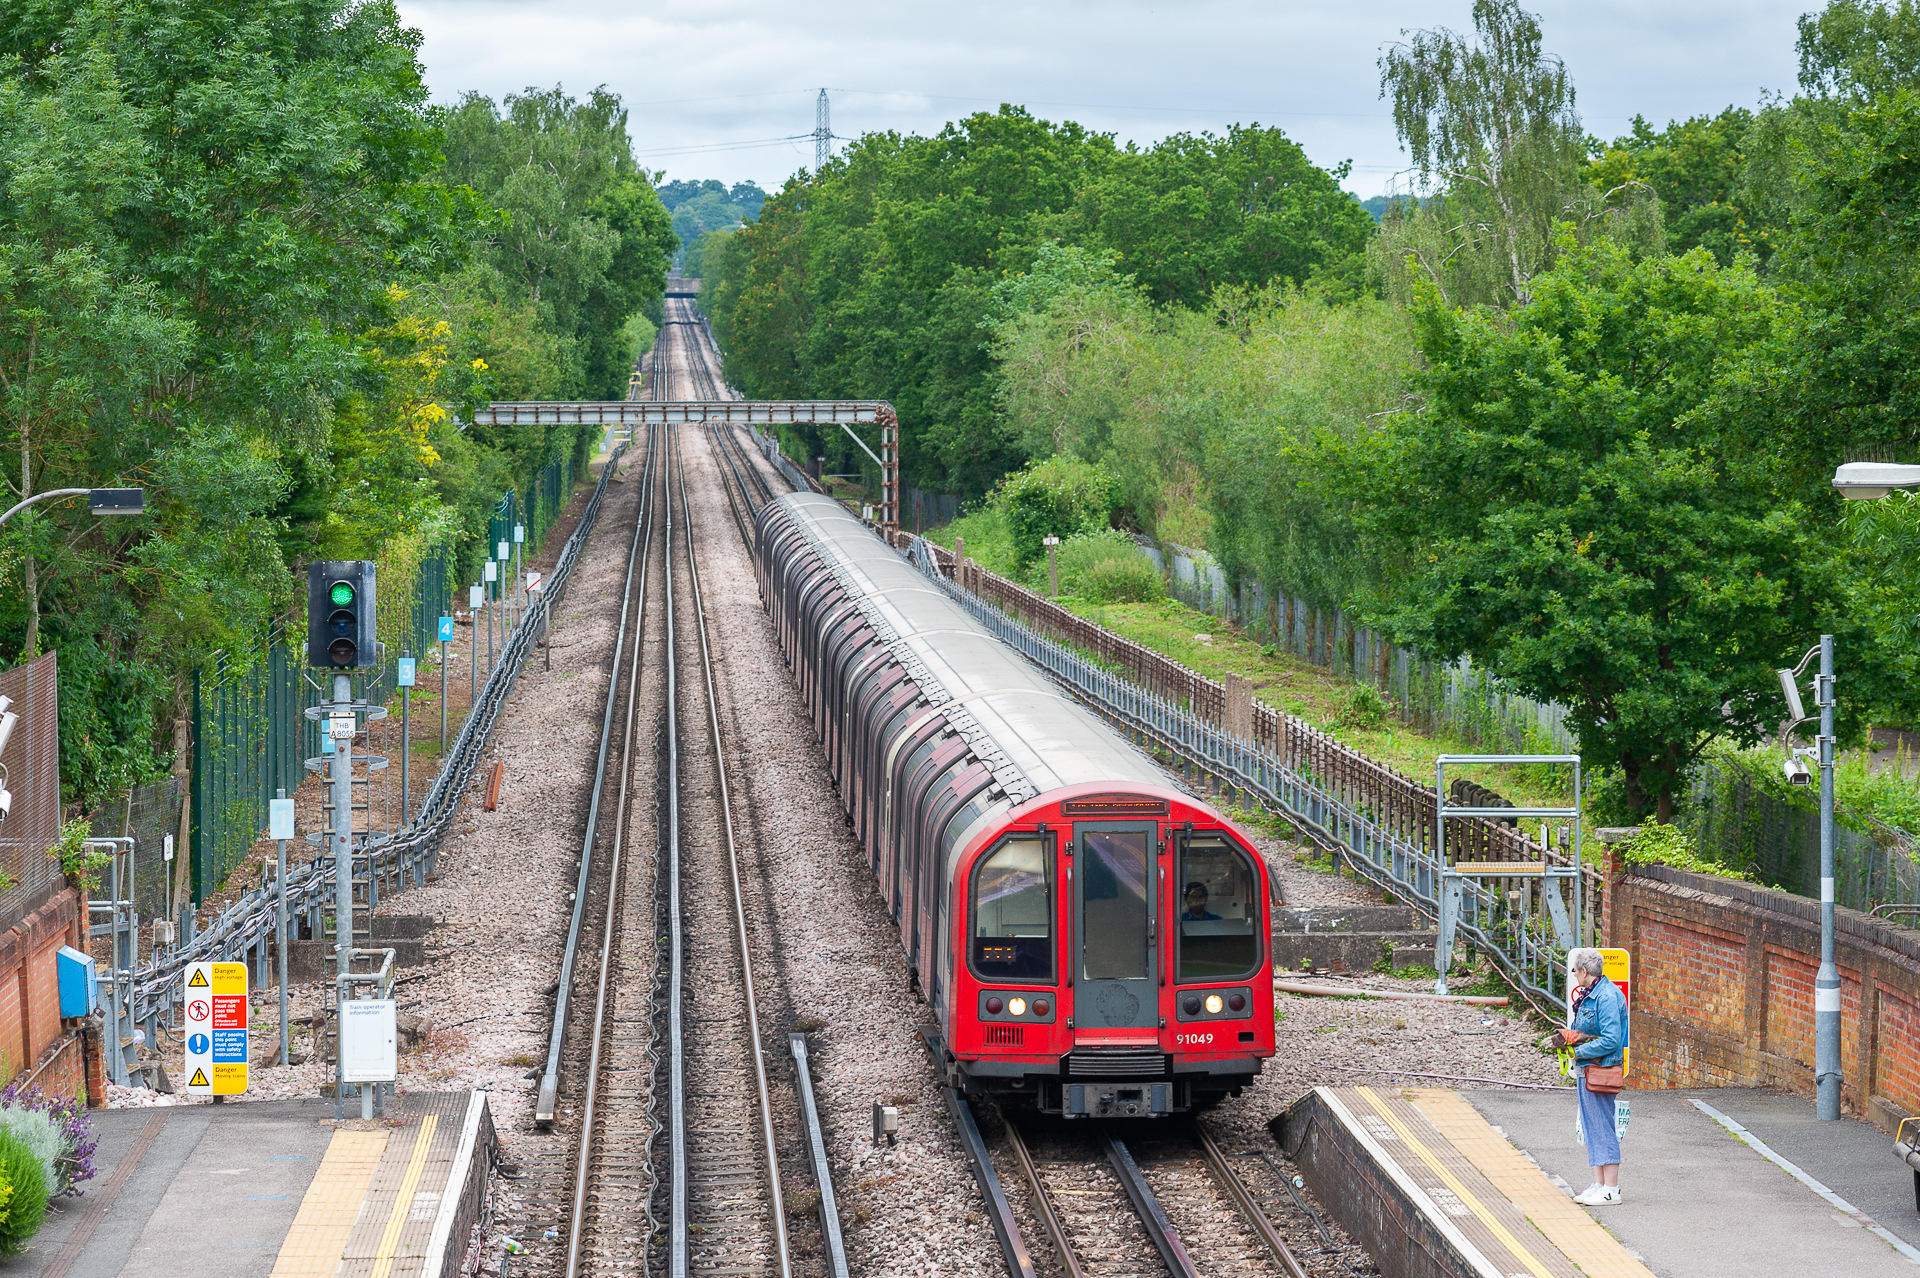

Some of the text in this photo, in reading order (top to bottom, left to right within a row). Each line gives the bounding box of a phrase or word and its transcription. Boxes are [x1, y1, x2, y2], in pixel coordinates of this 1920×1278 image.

[441, 623, 451, 635] 4
[402, 665, 411, 679] 3
[278, 810, 286, 829] 1
[1176, 1033, 1214, 1044] 91049
